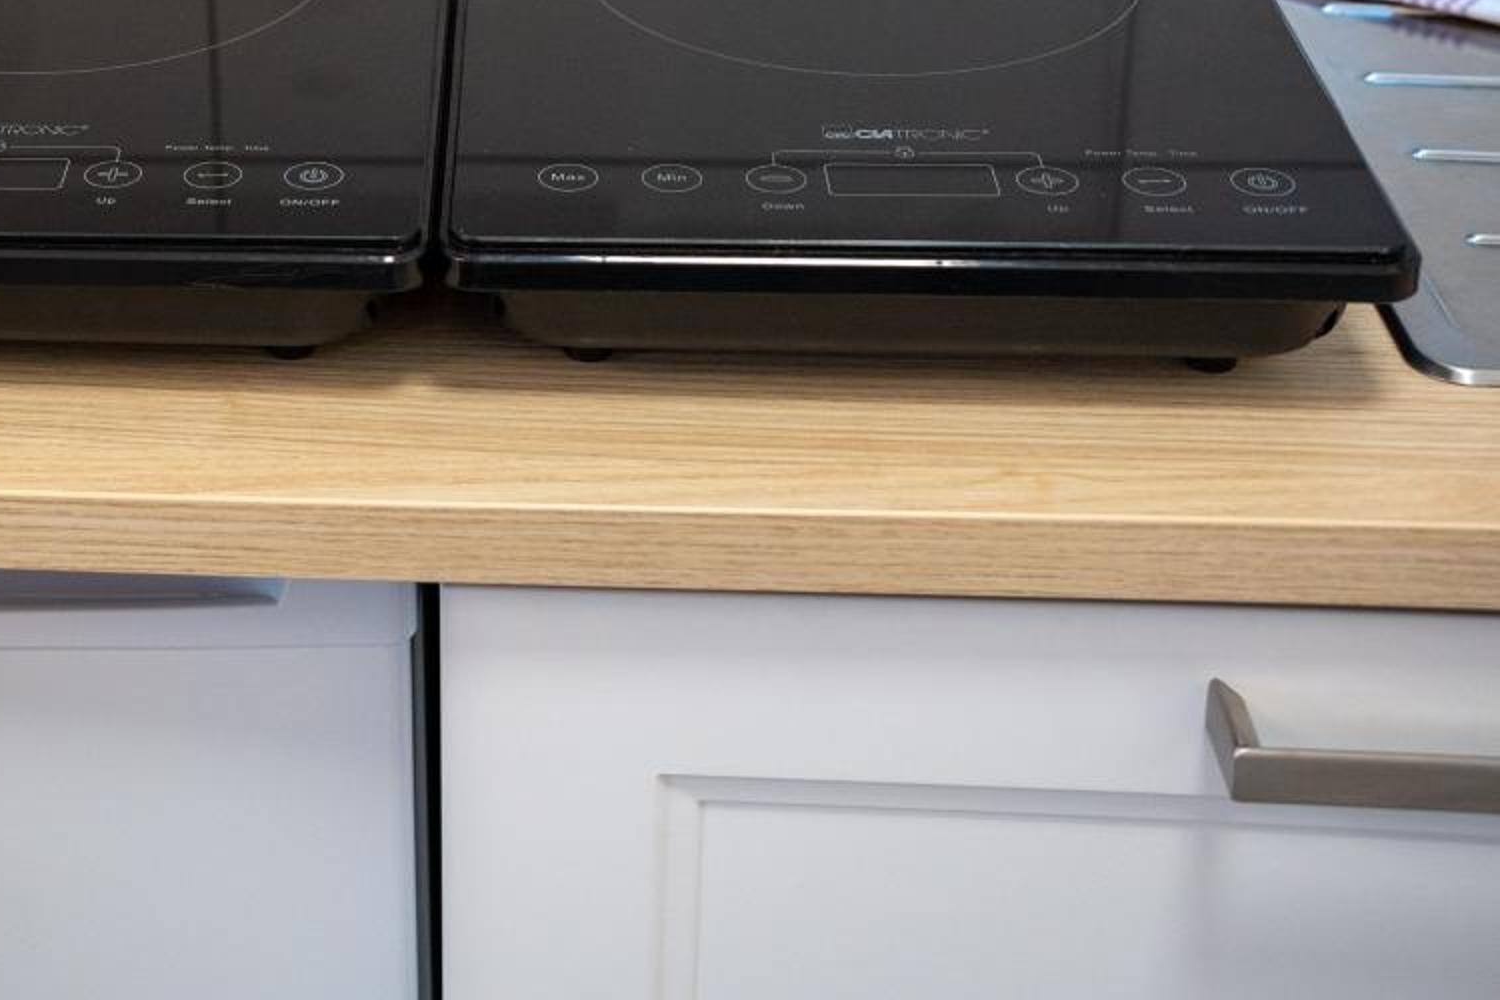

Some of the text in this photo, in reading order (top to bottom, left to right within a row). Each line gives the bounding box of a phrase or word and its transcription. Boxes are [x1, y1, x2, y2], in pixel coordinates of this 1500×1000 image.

[550, 172, 586, 182] Max
[656, 172, 688, 182] Min
[95, 197, 117, 206] Up
[279, 198, 341, 207] ON/OFF
